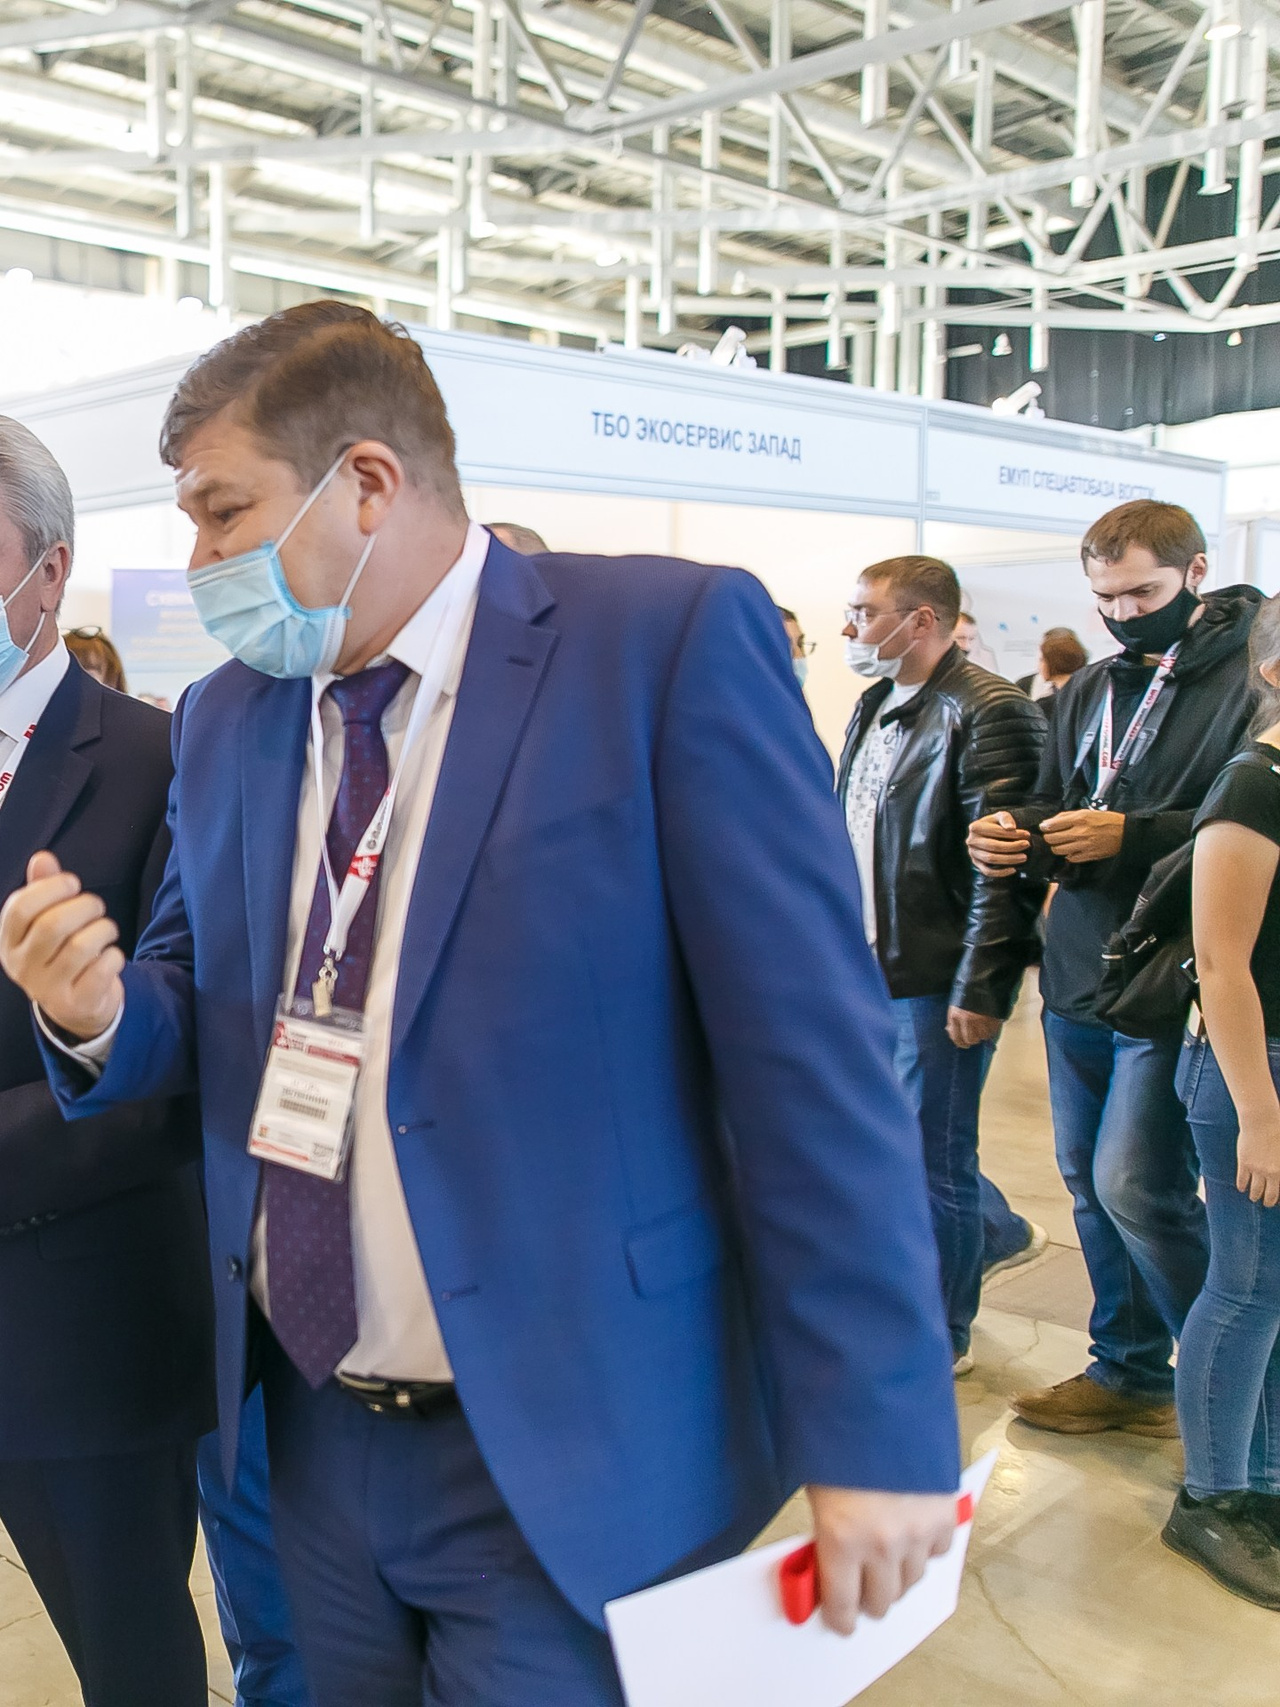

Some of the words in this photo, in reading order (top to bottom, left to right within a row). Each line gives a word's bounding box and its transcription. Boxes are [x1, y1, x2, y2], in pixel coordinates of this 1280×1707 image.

[591, 411, 630, 439] ТБО
[635, 417, 743, 452] ЭКОСЕРВИС
[748, 432, 802, 462] ЗАПАД
